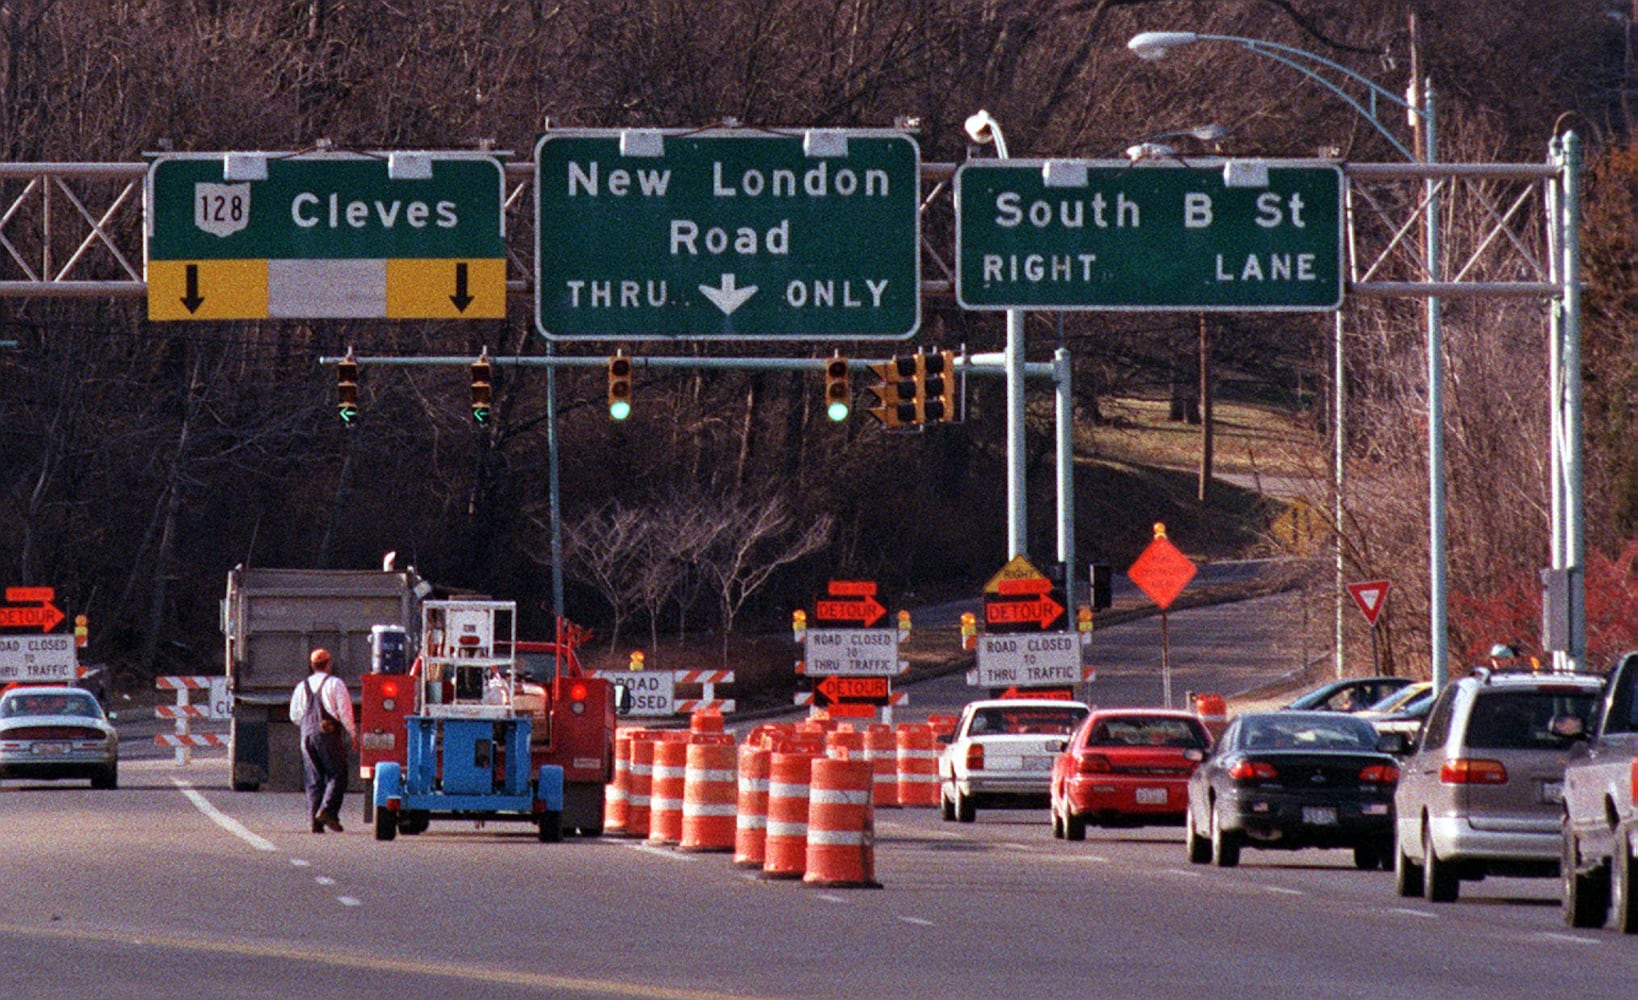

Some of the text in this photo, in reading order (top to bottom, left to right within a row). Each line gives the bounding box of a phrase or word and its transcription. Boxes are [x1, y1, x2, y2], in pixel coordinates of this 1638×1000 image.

[568, 161, 890, 197] New London
[200, 195, 243, 222] 128
[291, 192, 458, 228] Cleves
[995, 192, 1306, 228] South B St
[670, 219, 789, 255] Road
[983, 253, 1317, 282] RIGHT LANE
[567, 279, 888, 308] THRU ONLY
[819, 603, 877, 618] DETOUR
[989, 603, 1053, 620] DETOUR
[0, 639, 68, 651] OAD CLOSED
[814, 634, 891, 645] ROAD CLOSED
[987, 638, 1072, 653] ROAD CLOSED
[847, 648, 858, 657] TO
[1024, 655, 1036, 665] TO
[28, 664, 68, 676] TRAFFIC
[814, 659, 891, 671] THRU TRAFFIC
[987, 666, 1074, 681] THRU TRAFFIC
[826, 680, 884, 694] DETOUR
[630, 695, 667, 709] OSED
